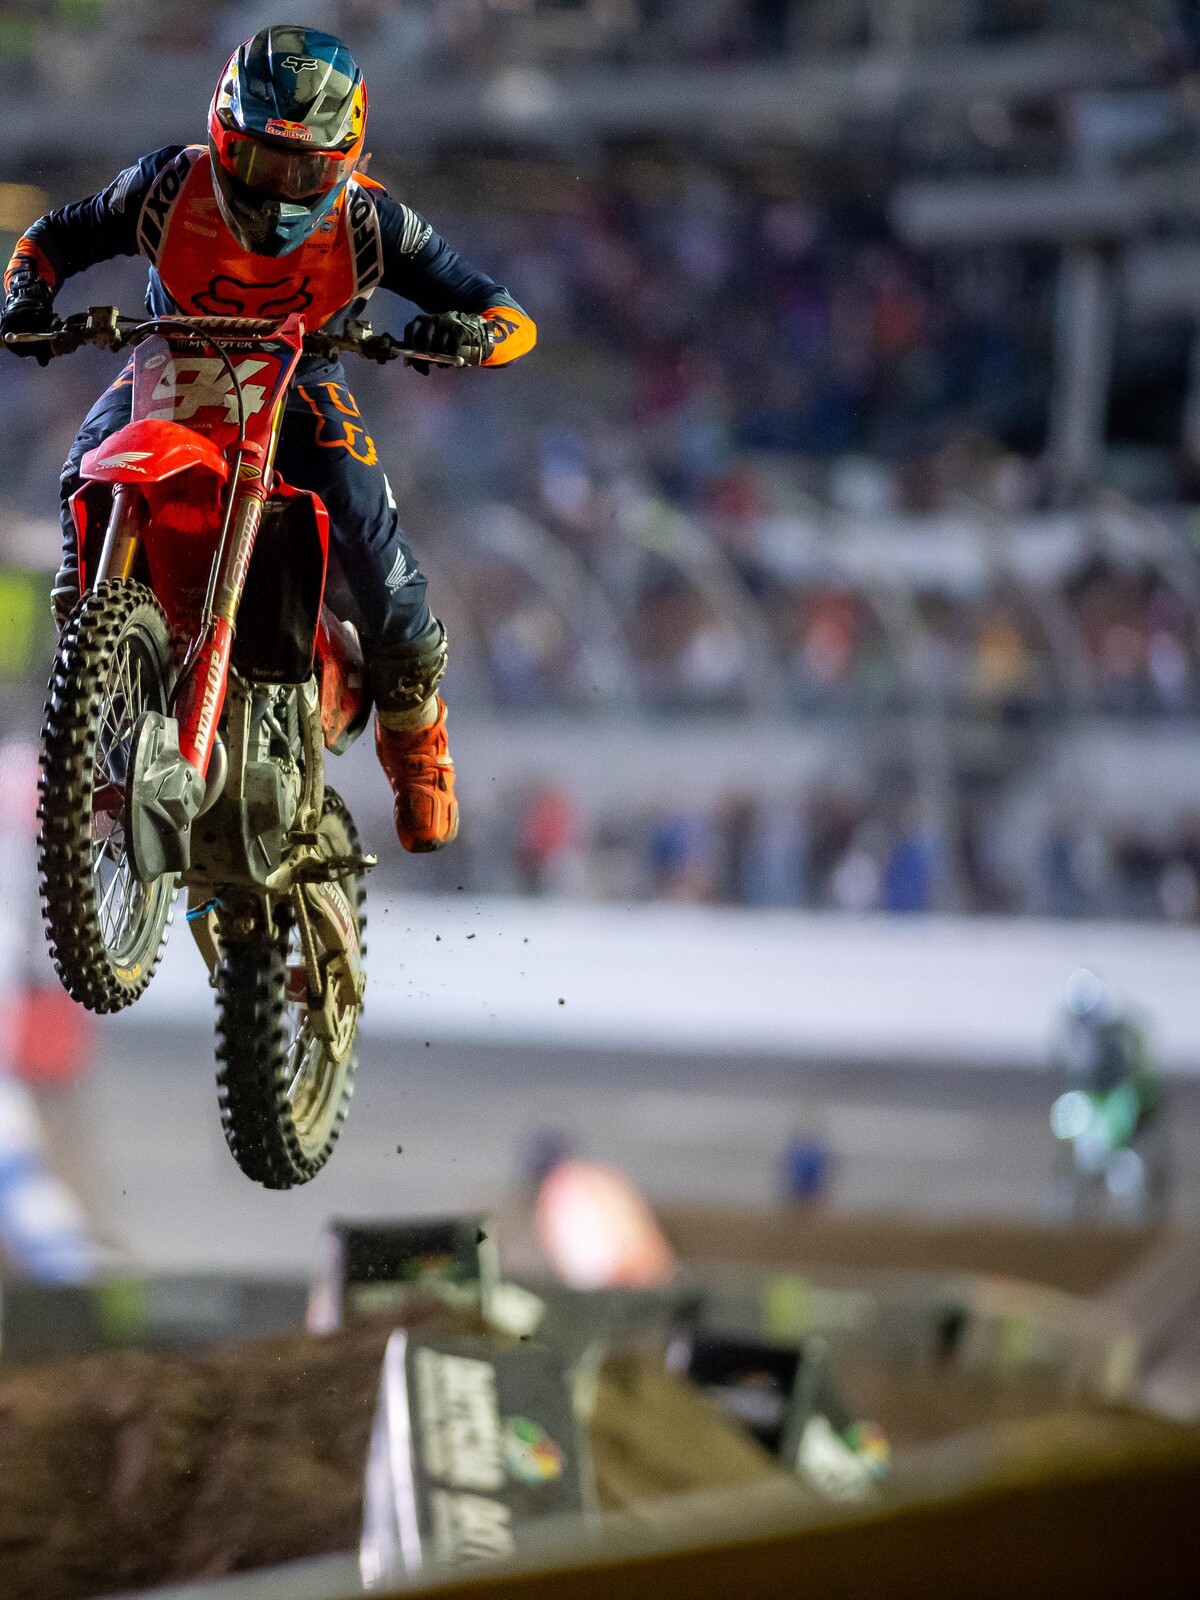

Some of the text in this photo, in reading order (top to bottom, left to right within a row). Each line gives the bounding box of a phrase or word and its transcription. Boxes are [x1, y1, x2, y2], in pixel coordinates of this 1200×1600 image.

[265, 123, 312, 141] Red Bull
[492, 314, 520, 344] OX
[144, 357, 270, 425] 94
[94, 461, 147, 474] HONDA
[390, 569, 417, 594] HONDA
[194, 649, 221, 758] DUNLOP
